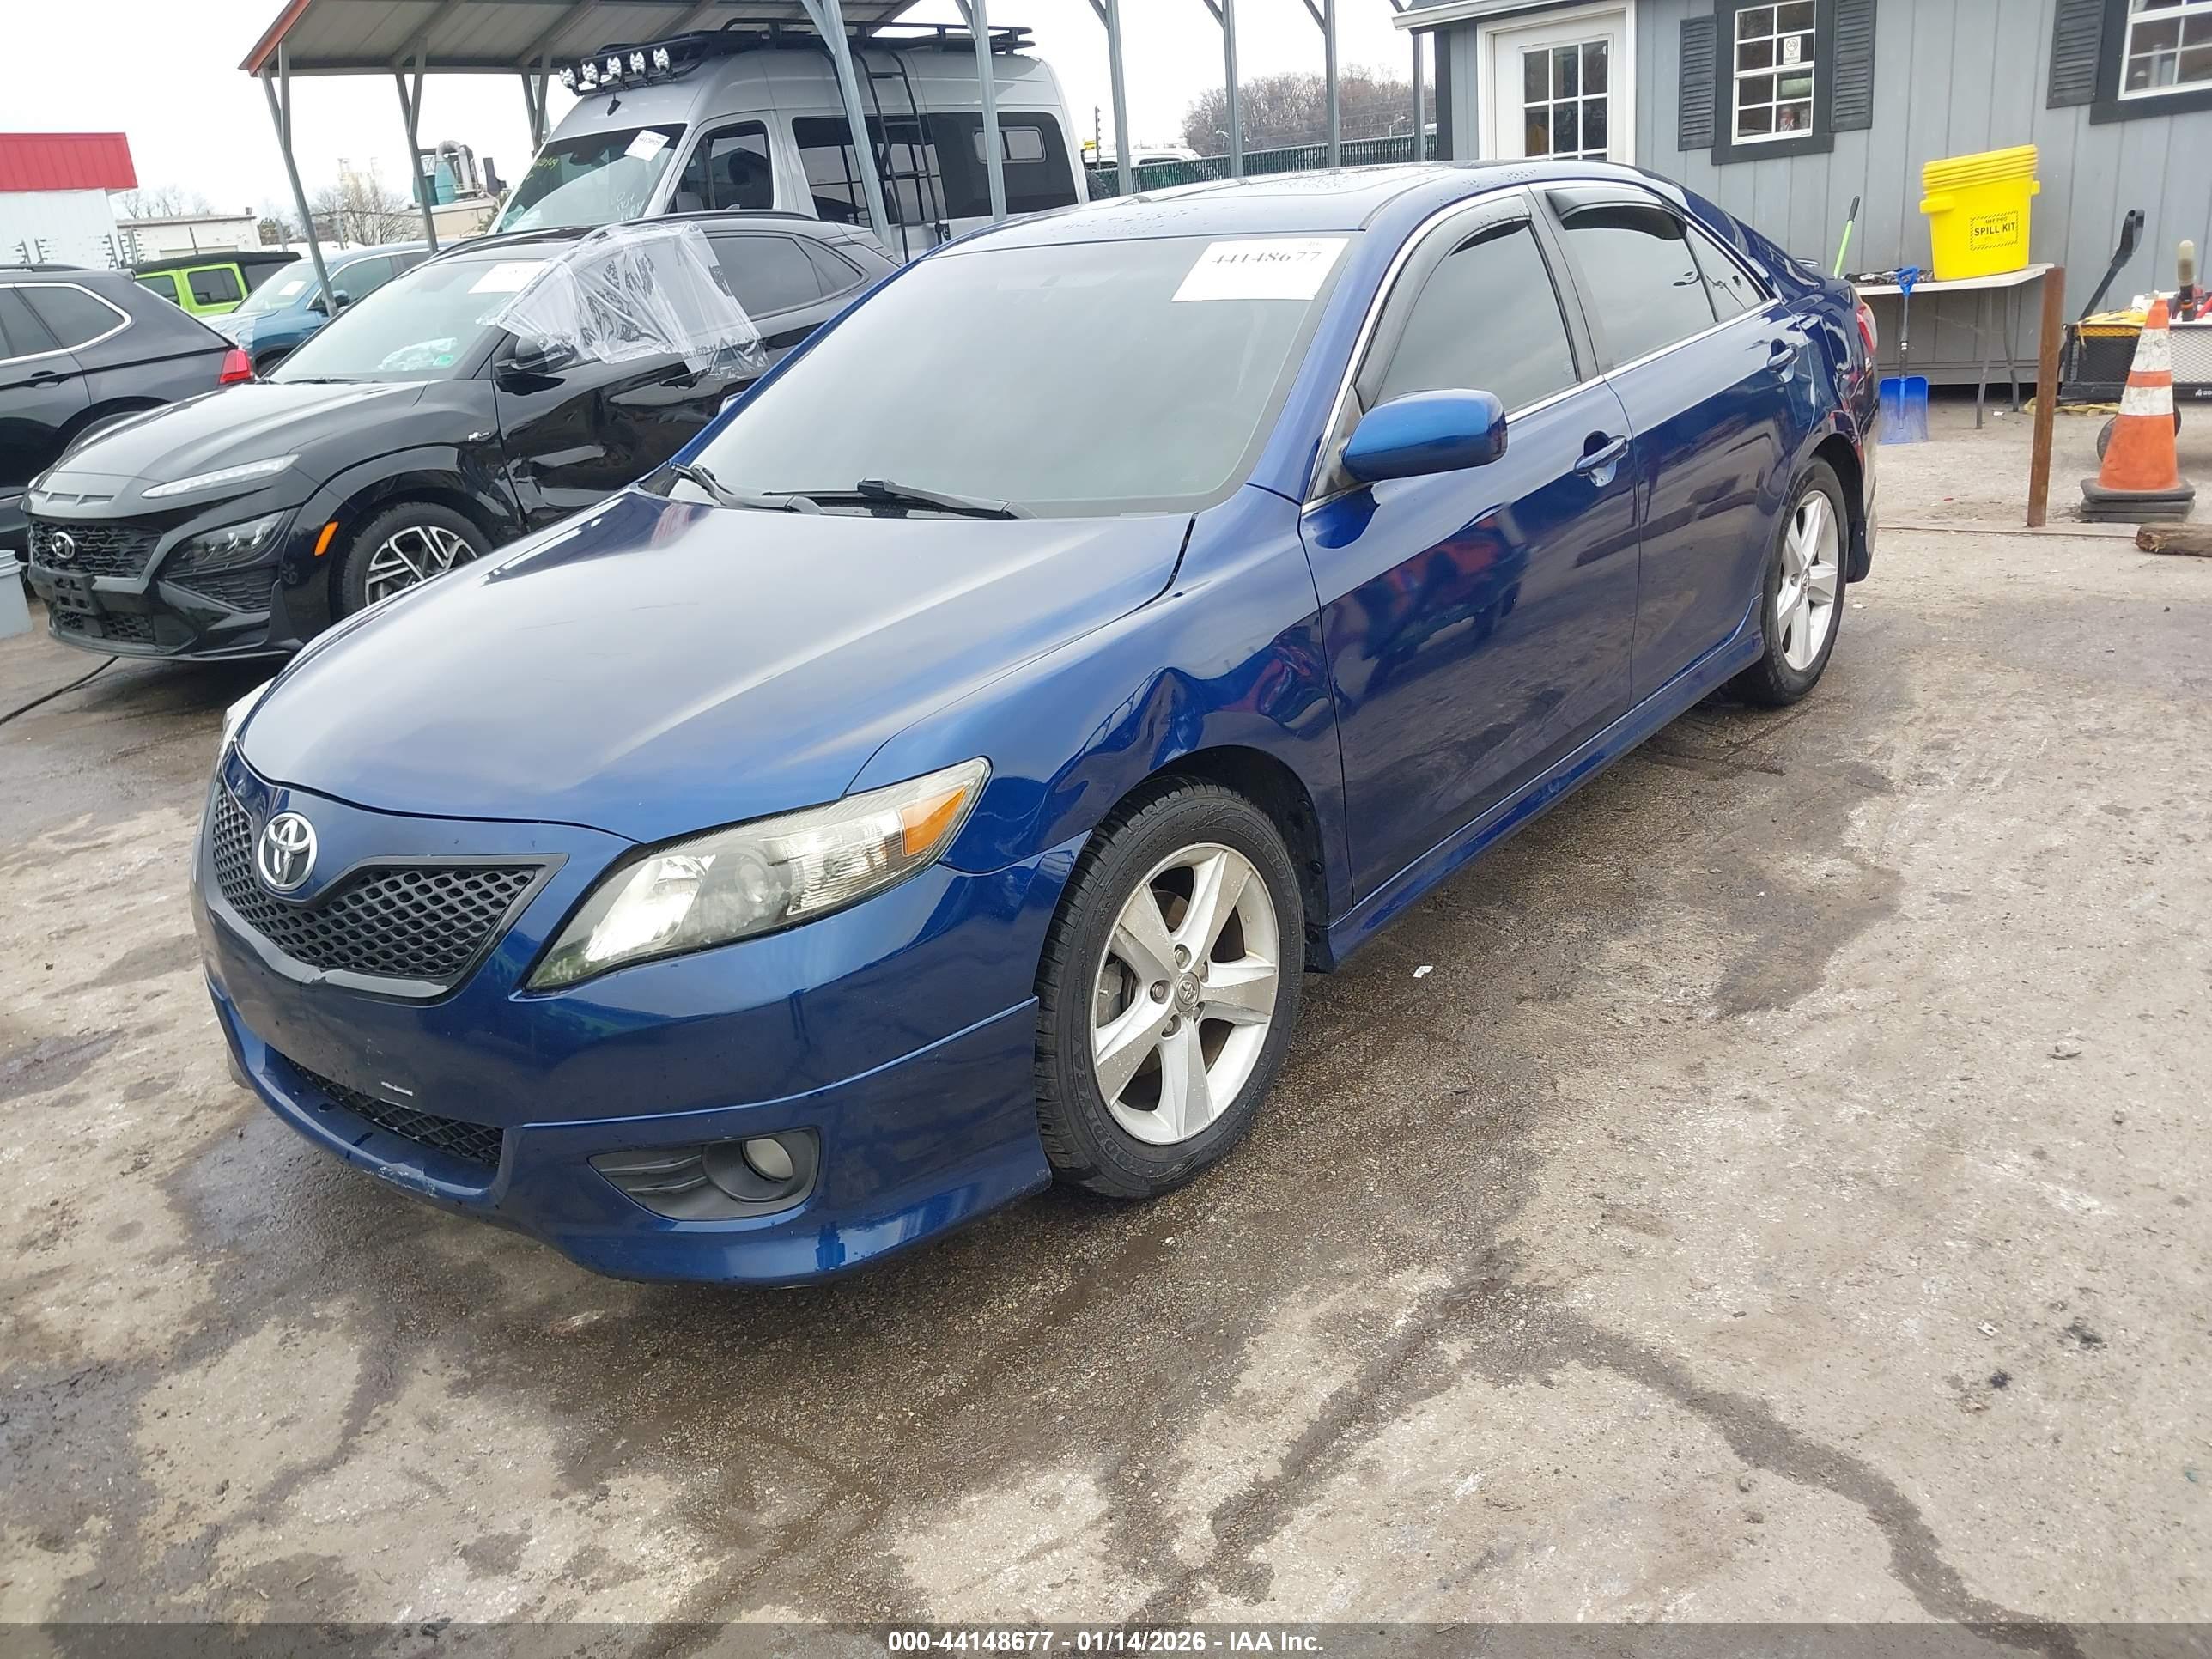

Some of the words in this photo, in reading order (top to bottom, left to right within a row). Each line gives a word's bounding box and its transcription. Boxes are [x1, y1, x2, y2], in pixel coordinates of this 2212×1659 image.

[1974, 225, 2000, 236] SPILL
[2002, 222, 2015, 233] KIT
[1212, 251, 1322, 264] 44148677
